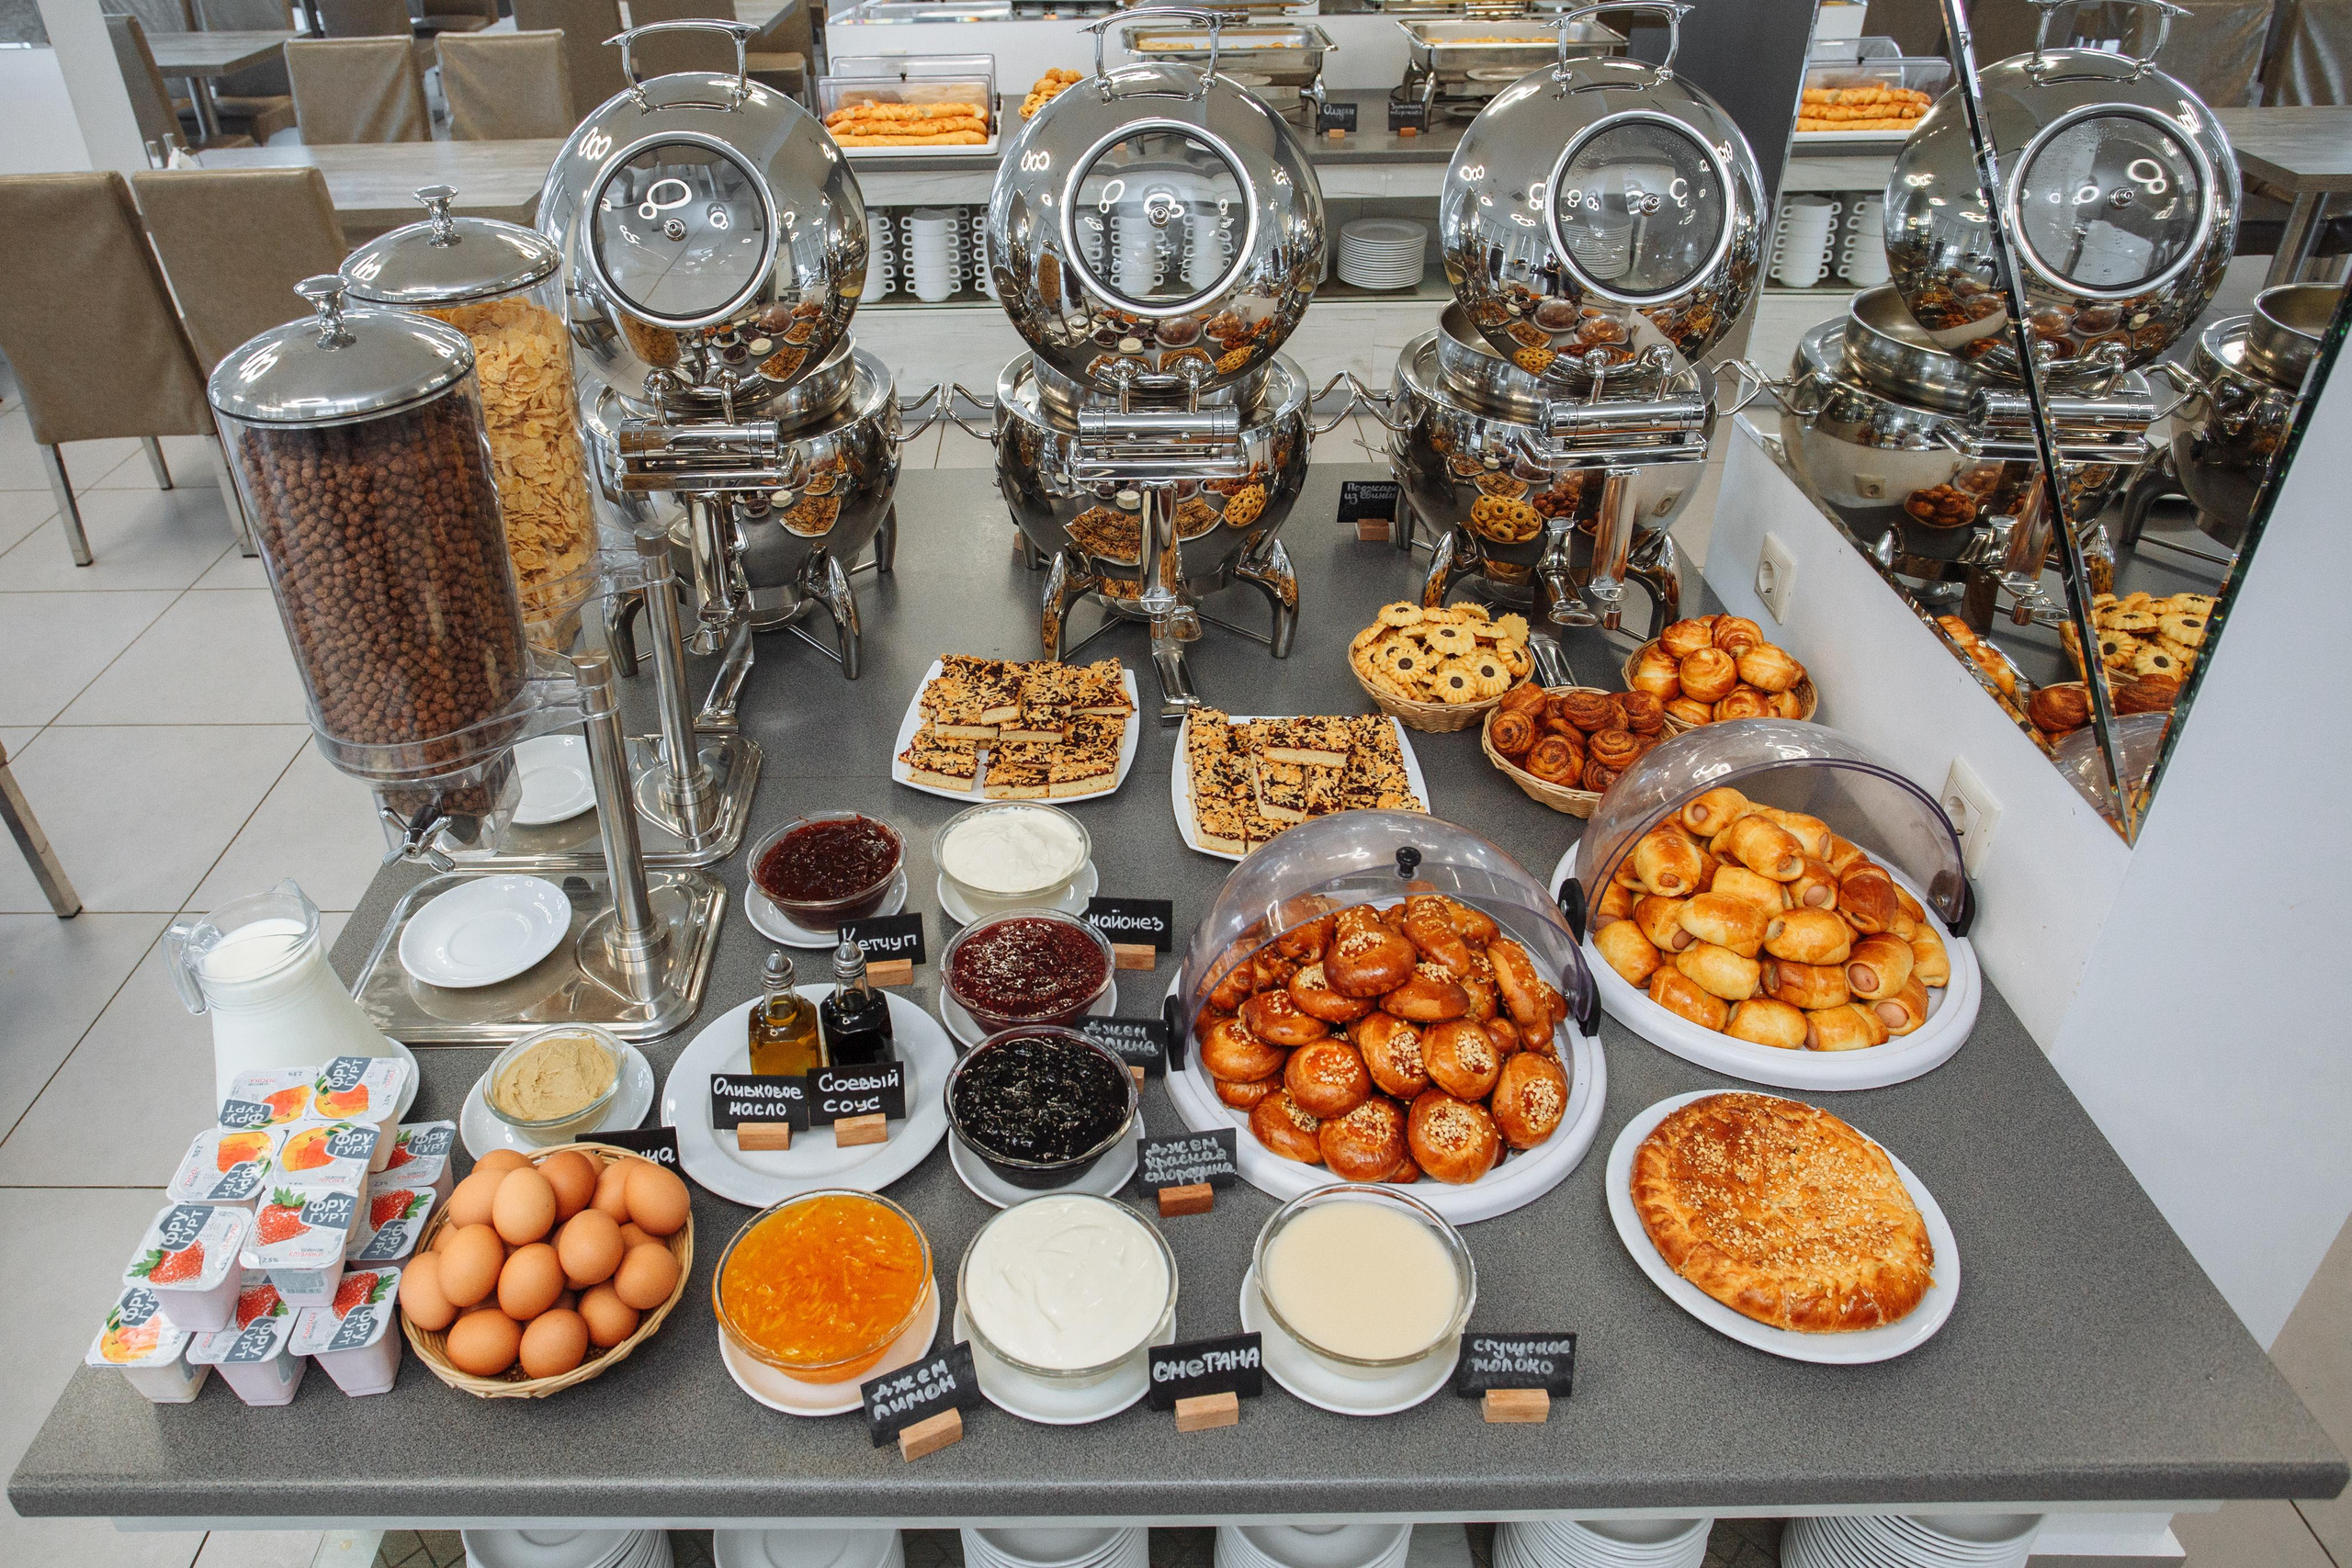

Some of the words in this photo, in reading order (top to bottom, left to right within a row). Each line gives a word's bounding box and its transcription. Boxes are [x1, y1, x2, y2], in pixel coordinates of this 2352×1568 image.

[345, 1059, 364, 1087] ГУРТ
[819, 1069, 899, 1092] Соевый
[713, 1077, 804, 1100] Оливковое
[226, 1104, 264, 1113] ГУРТ
[729, 1101, 787, 1117] масло
[823, 1096, 881, 1113] соус
[334, 1145, 372, 1155] ГУРТ
[414, 1142, 448, 1154] ГУРТ
[219, 1169, 243, 1197] ГУРТ
[178, 1210, 204, 1244] ГУРТ
[309, 1213, 350, 1224] ГУРТ
[370, 1227, 390, 1256] ГУРТ
[139, 1292, 157, 1319] ГУР
[338, 1314, 359, 1345] ГУРТ
[235, 1325, 258, 1359] ГУРТ
[1471, 1358, 1555, 1374] молоко
